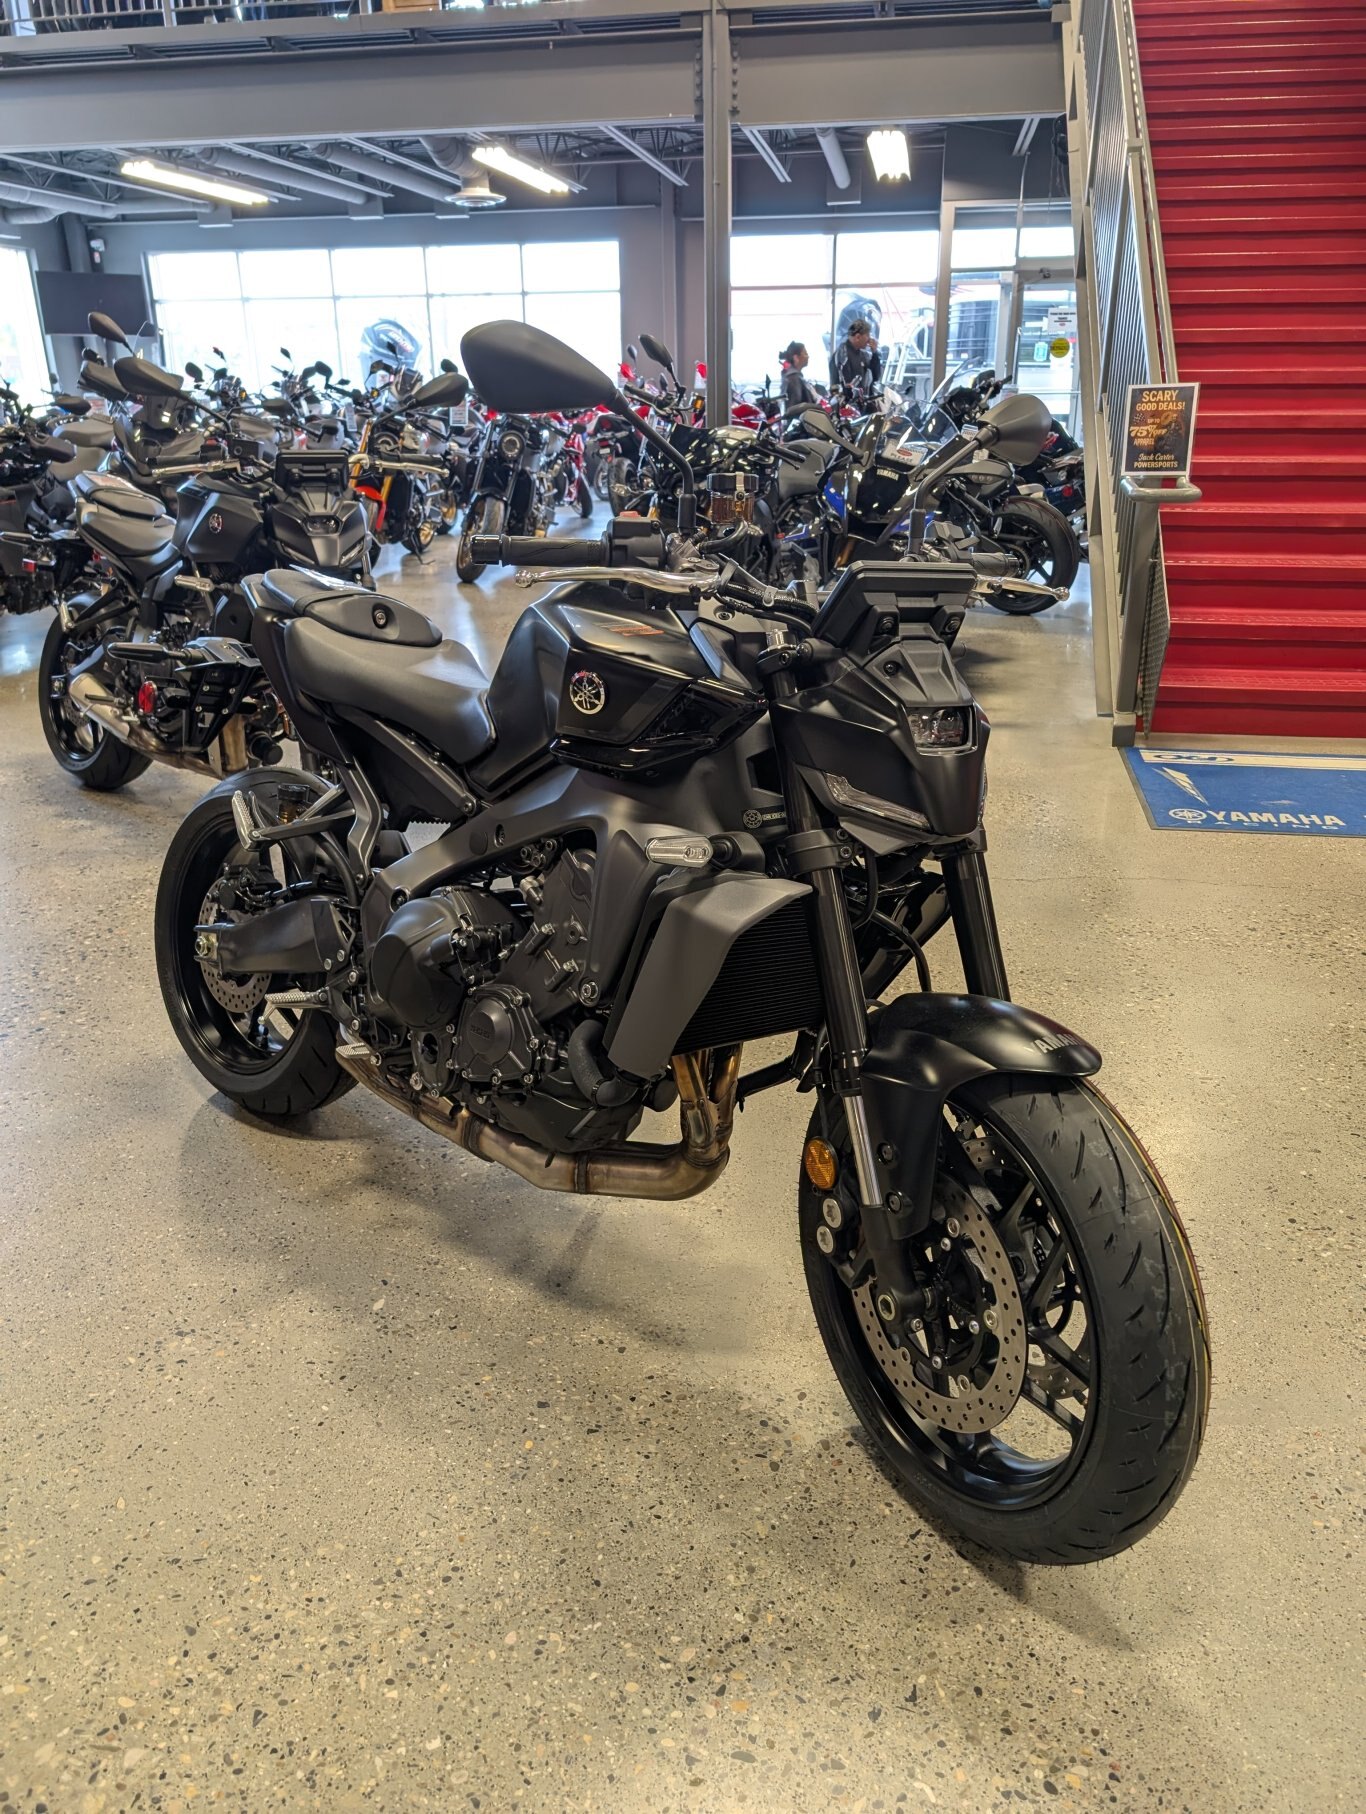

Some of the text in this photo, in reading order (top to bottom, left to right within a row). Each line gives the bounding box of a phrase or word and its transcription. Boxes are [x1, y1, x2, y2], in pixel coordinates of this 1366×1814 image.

[1142, 390, 1179, 401] SCARY
[1136, 401, 1186, 411] GOOD DEALS!
[1130, 425, 1157, 437] 75%
[1138, 453, 1154, 461] Jack
[876, 468, 899, 481] YAMAHA
[1207, 810, 1346, 826] YAMAHA
